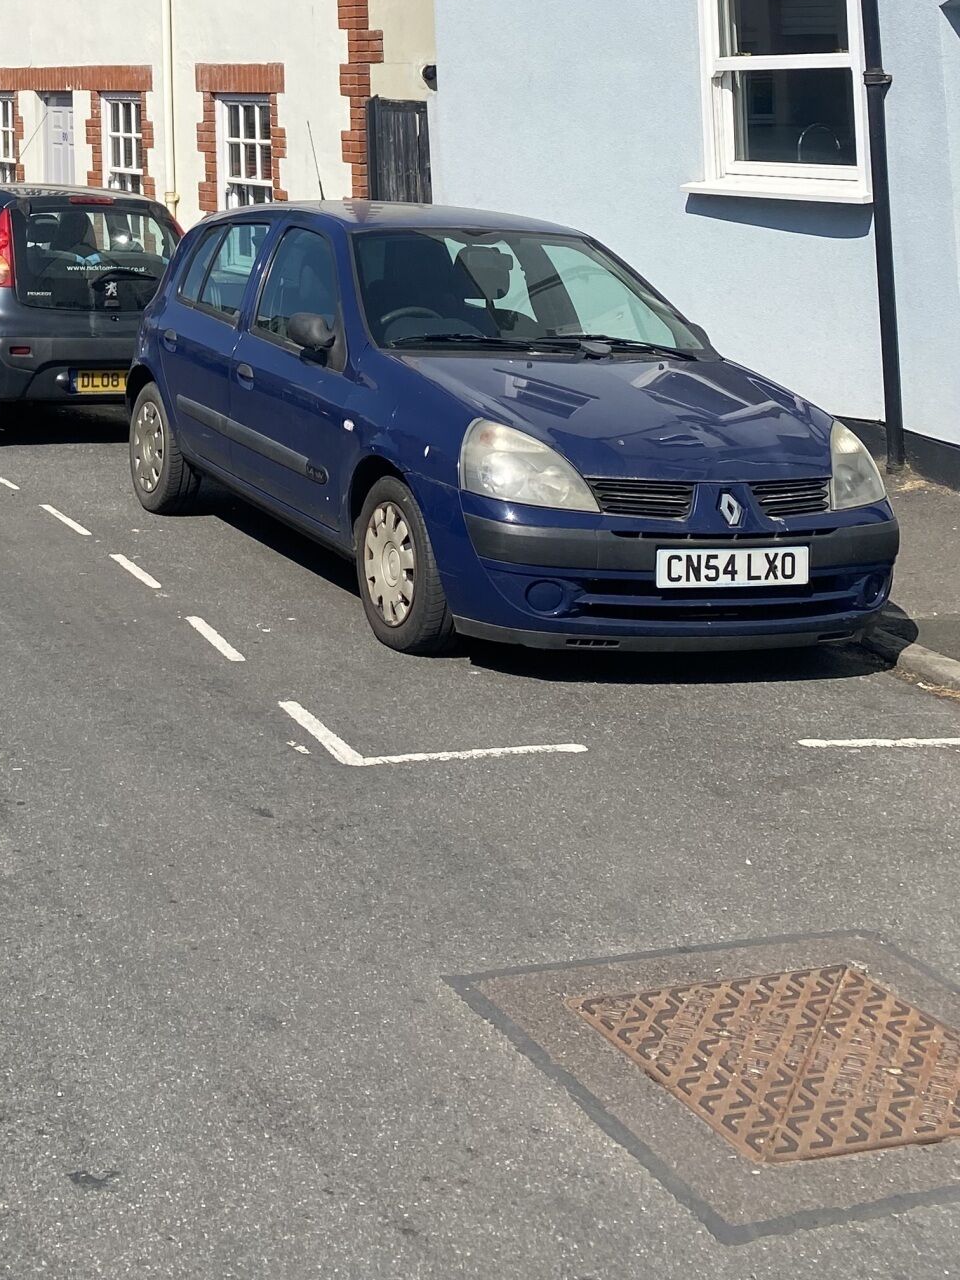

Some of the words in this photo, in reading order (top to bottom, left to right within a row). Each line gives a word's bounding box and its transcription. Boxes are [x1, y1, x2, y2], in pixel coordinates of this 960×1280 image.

[81, 372, 119, 388] DL08
[667, 554, 738, 582] CN54
[746, 552, 796, 581] LXO
